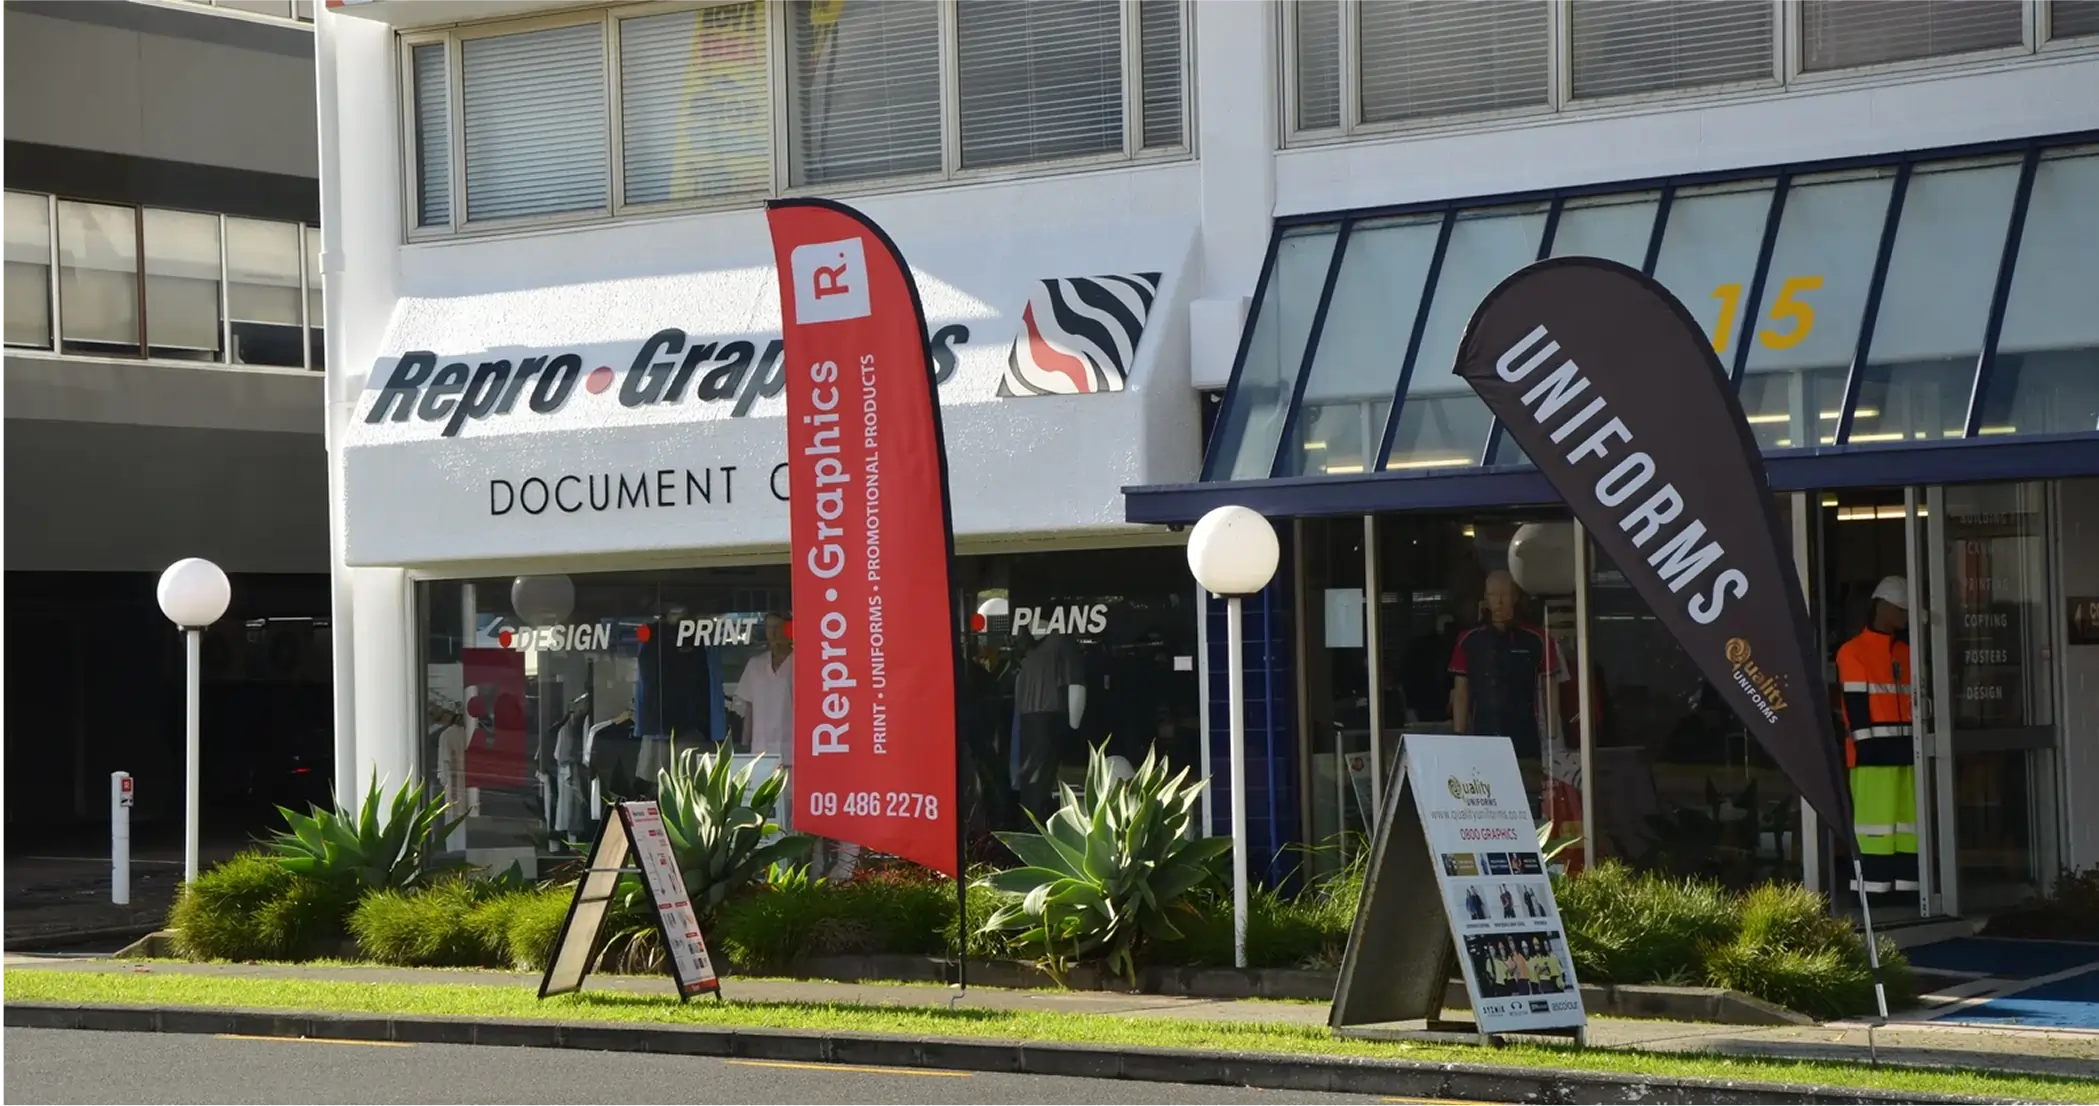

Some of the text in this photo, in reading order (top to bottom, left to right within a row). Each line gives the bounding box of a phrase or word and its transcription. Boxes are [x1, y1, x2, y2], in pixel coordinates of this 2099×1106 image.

[365, 350, 583, 437] Repro
[490, 466, 737, 517] DOCUMENT
[1495, 324, 1749, 625] UNIFORMS
[804, 360, 857, 757] Repro Graphics
[860, 353, 888, 755] PRINT UNIFORMS PROMOTIONAL PRODUCTS
[515, 603, 1109, 653] DESIGN PRINT PLANS
[1963, 613, 2008, 628] COPYING
[1964, 650, 2008, 665] POSTERS
[1732, 670, 1779, 724] UNIFORMS
[1966, 686, 2003, 701] DESIGN
[809, 791, 939, 821] 09 486 2278
[1467, 798, 1498, 807] UNIFORMS
[1460, 828, 1518, 841] 0800 GRAPHICS
